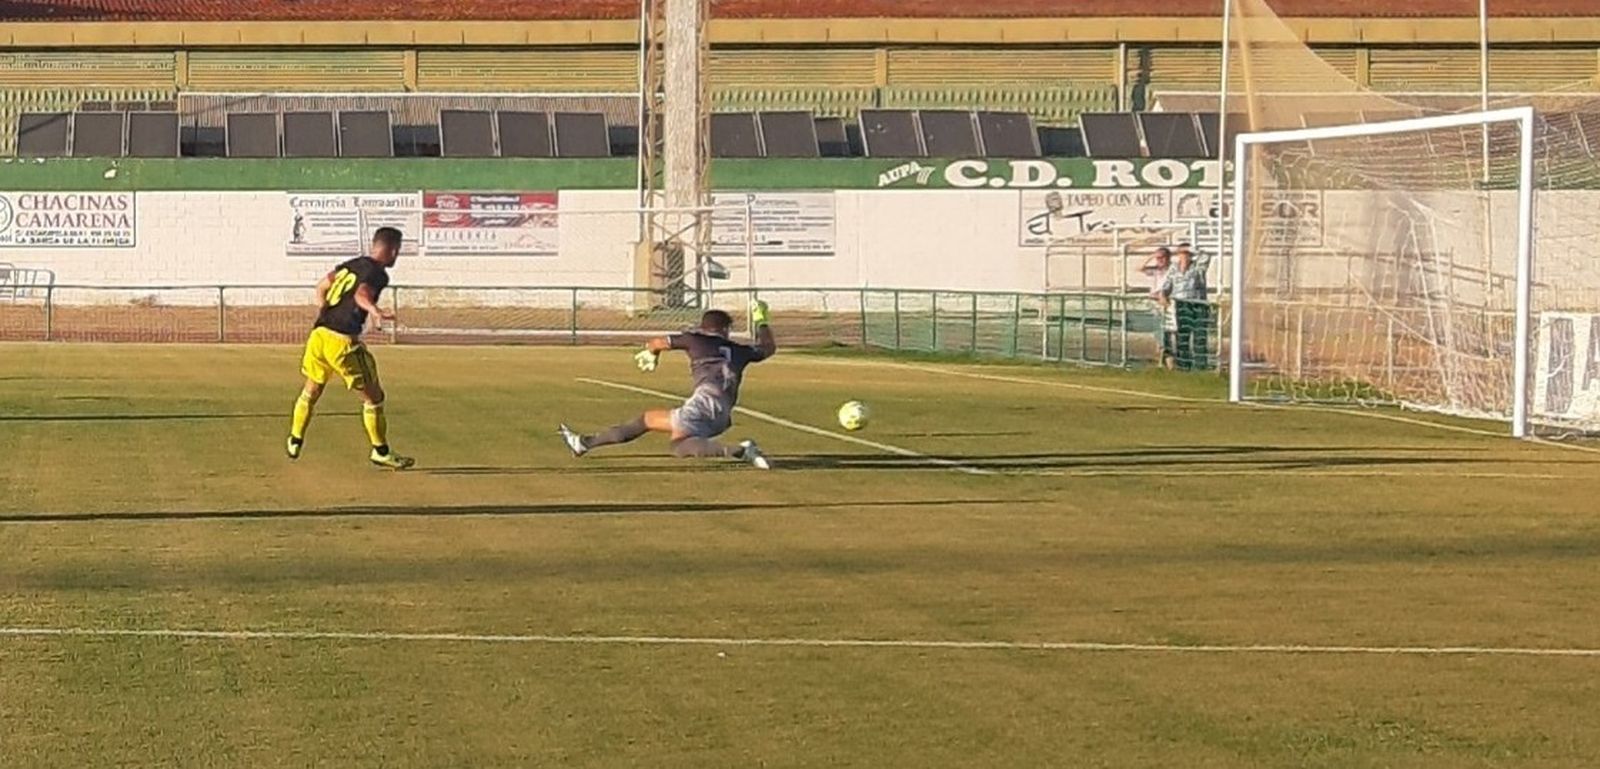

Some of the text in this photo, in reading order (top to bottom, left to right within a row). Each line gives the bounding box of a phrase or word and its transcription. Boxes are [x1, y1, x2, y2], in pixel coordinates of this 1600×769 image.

[878, 161, 922, 187] AUPA
[944, 159, 1072, 187] C.D.
[18, 194, 128, 211] CHACINAS
[1067, 193, 1164, 206] TAPEO CON ARTE
[15, 212, 131, 228] CAMARENA
